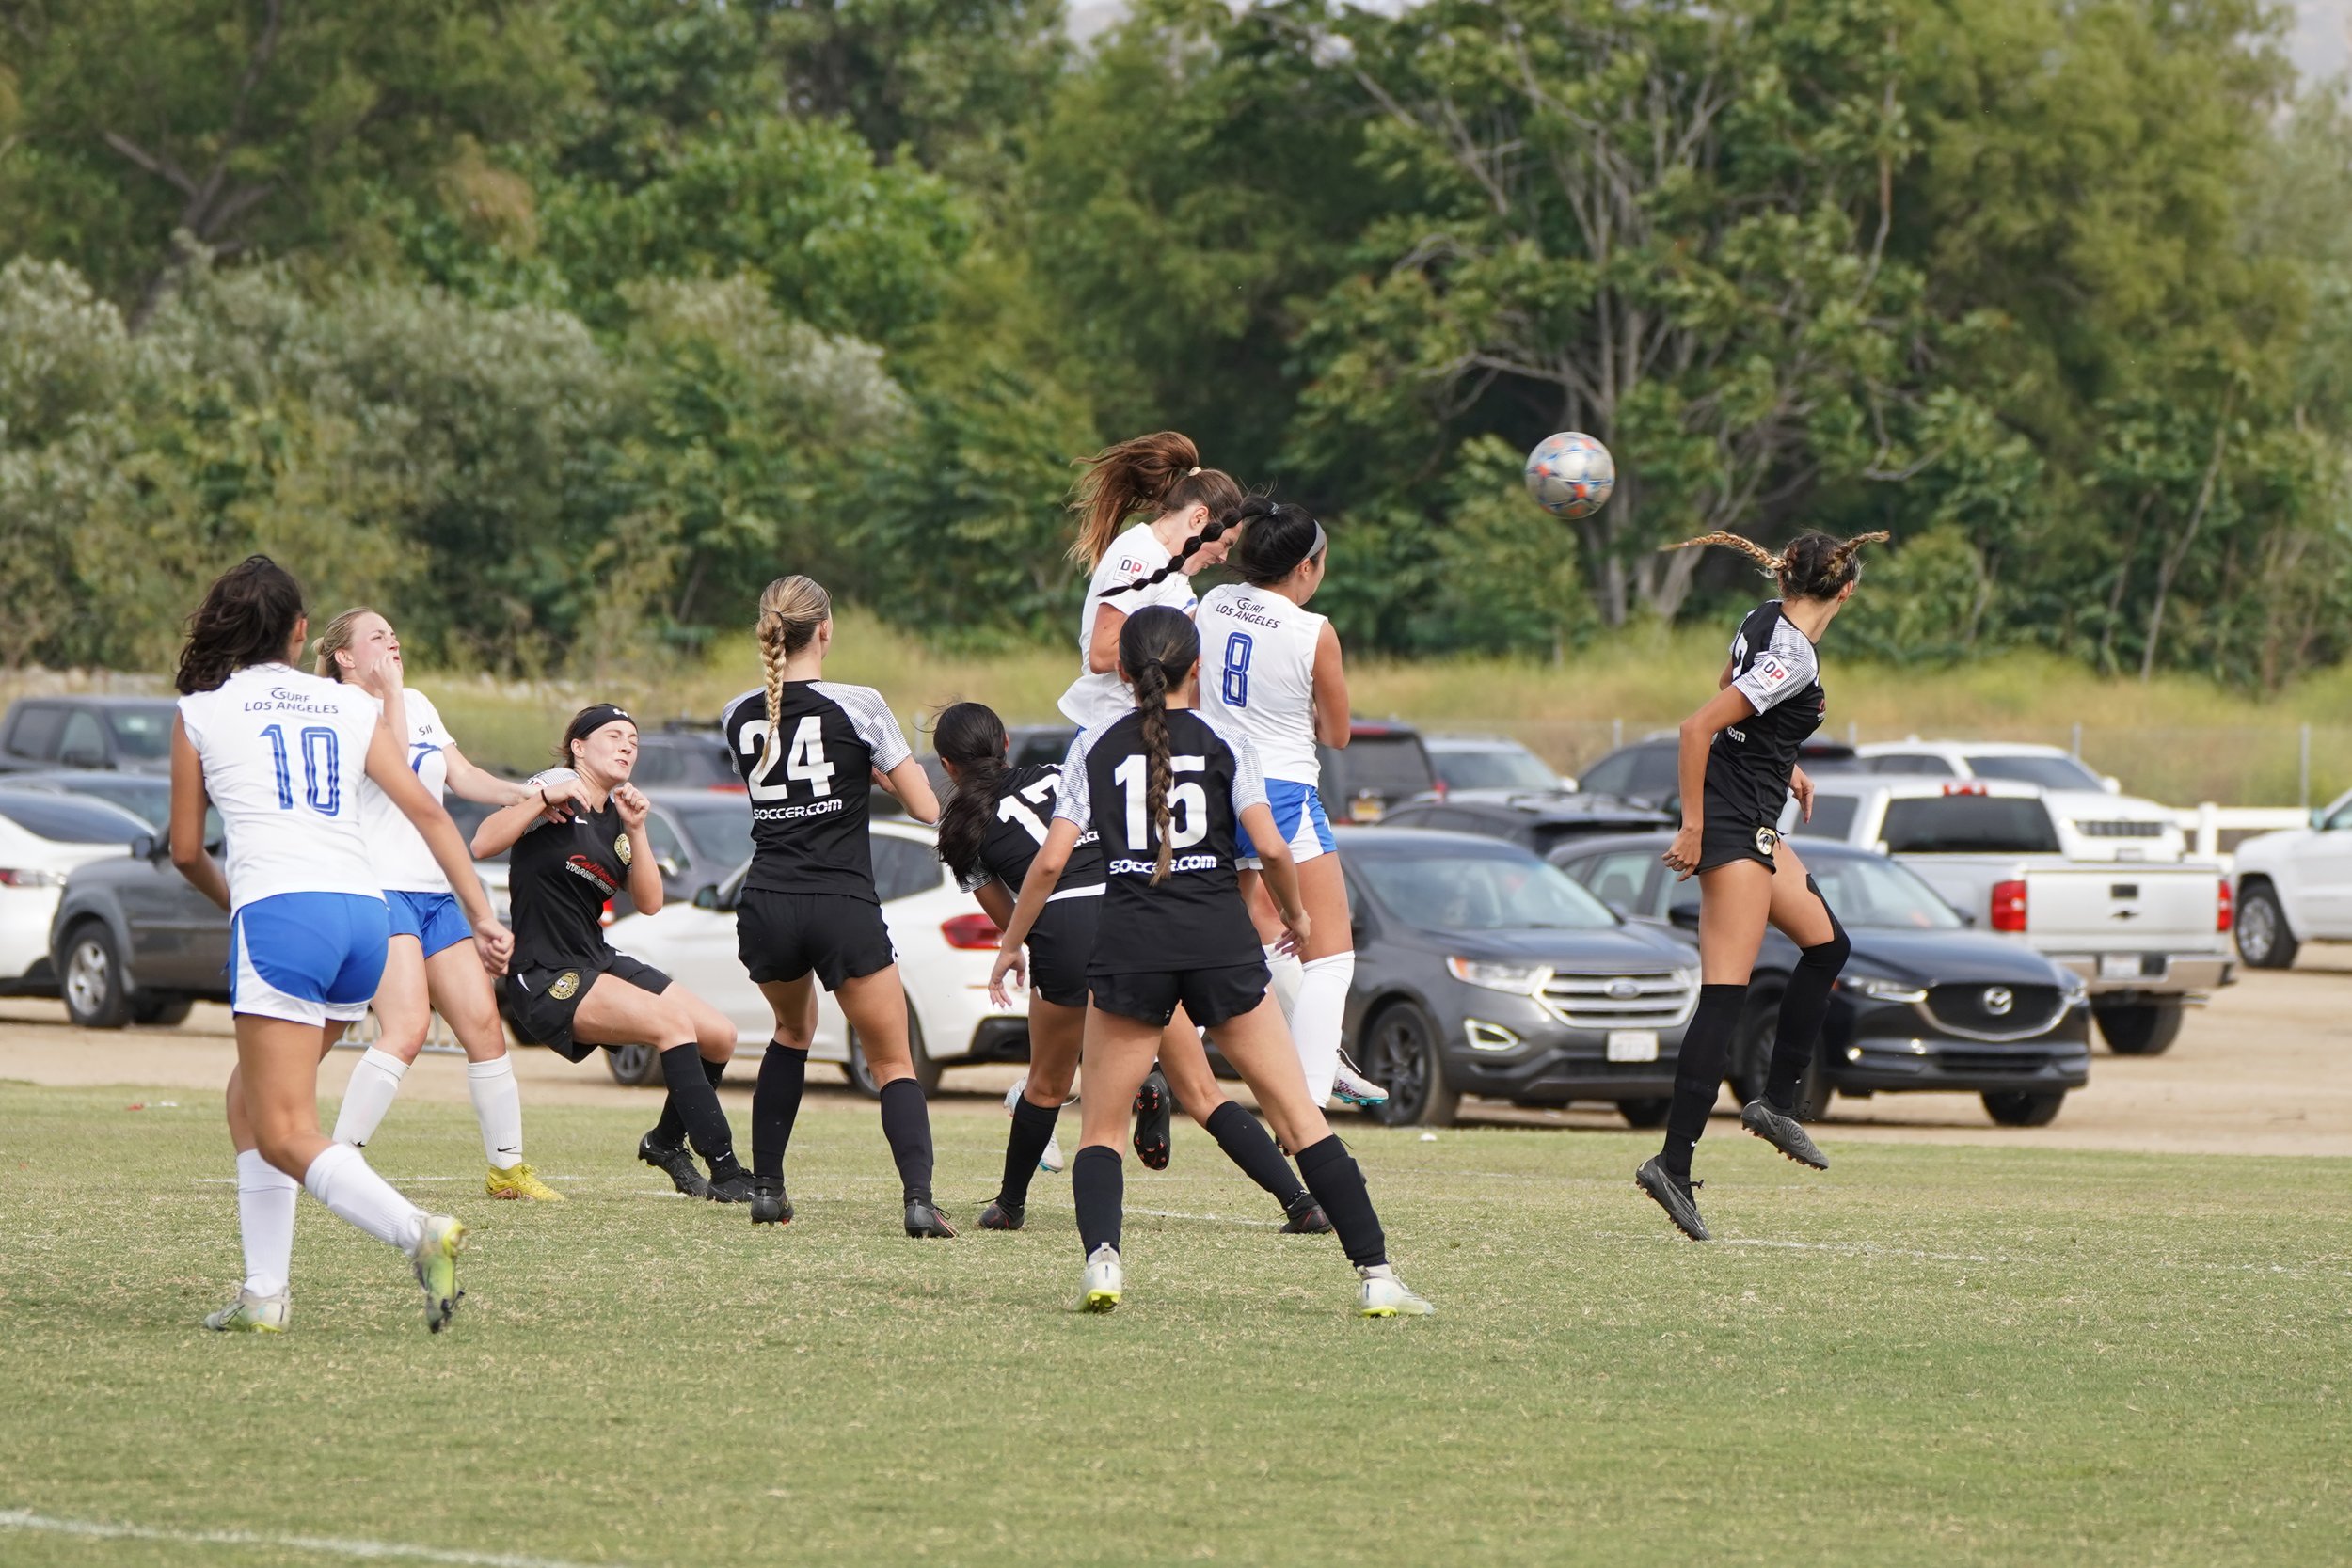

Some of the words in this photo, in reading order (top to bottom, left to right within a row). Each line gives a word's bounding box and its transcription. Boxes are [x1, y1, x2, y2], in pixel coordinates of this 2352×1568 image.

[1120, 559, 1142, 574] DP
[1236, 597, 1265, 613] SURF
[1216, 603, 1235, 616] LOS
[1233, 610, 1281, 629] ANGELES
[1222, 631, 1253, 708] 8
[1763, 660, 1785, 680] DP
[271, 688, 310, 703] SURF
[245, 702, 272, 712] LOS
[276, 702, 339, 714] ANGELES
[739, 716, 835, 800] 24
[258, 723, 340, 816] 10
[753, 799, 843, 820] SOCCER.COM
[1115, 754, 1207, 850] 15
